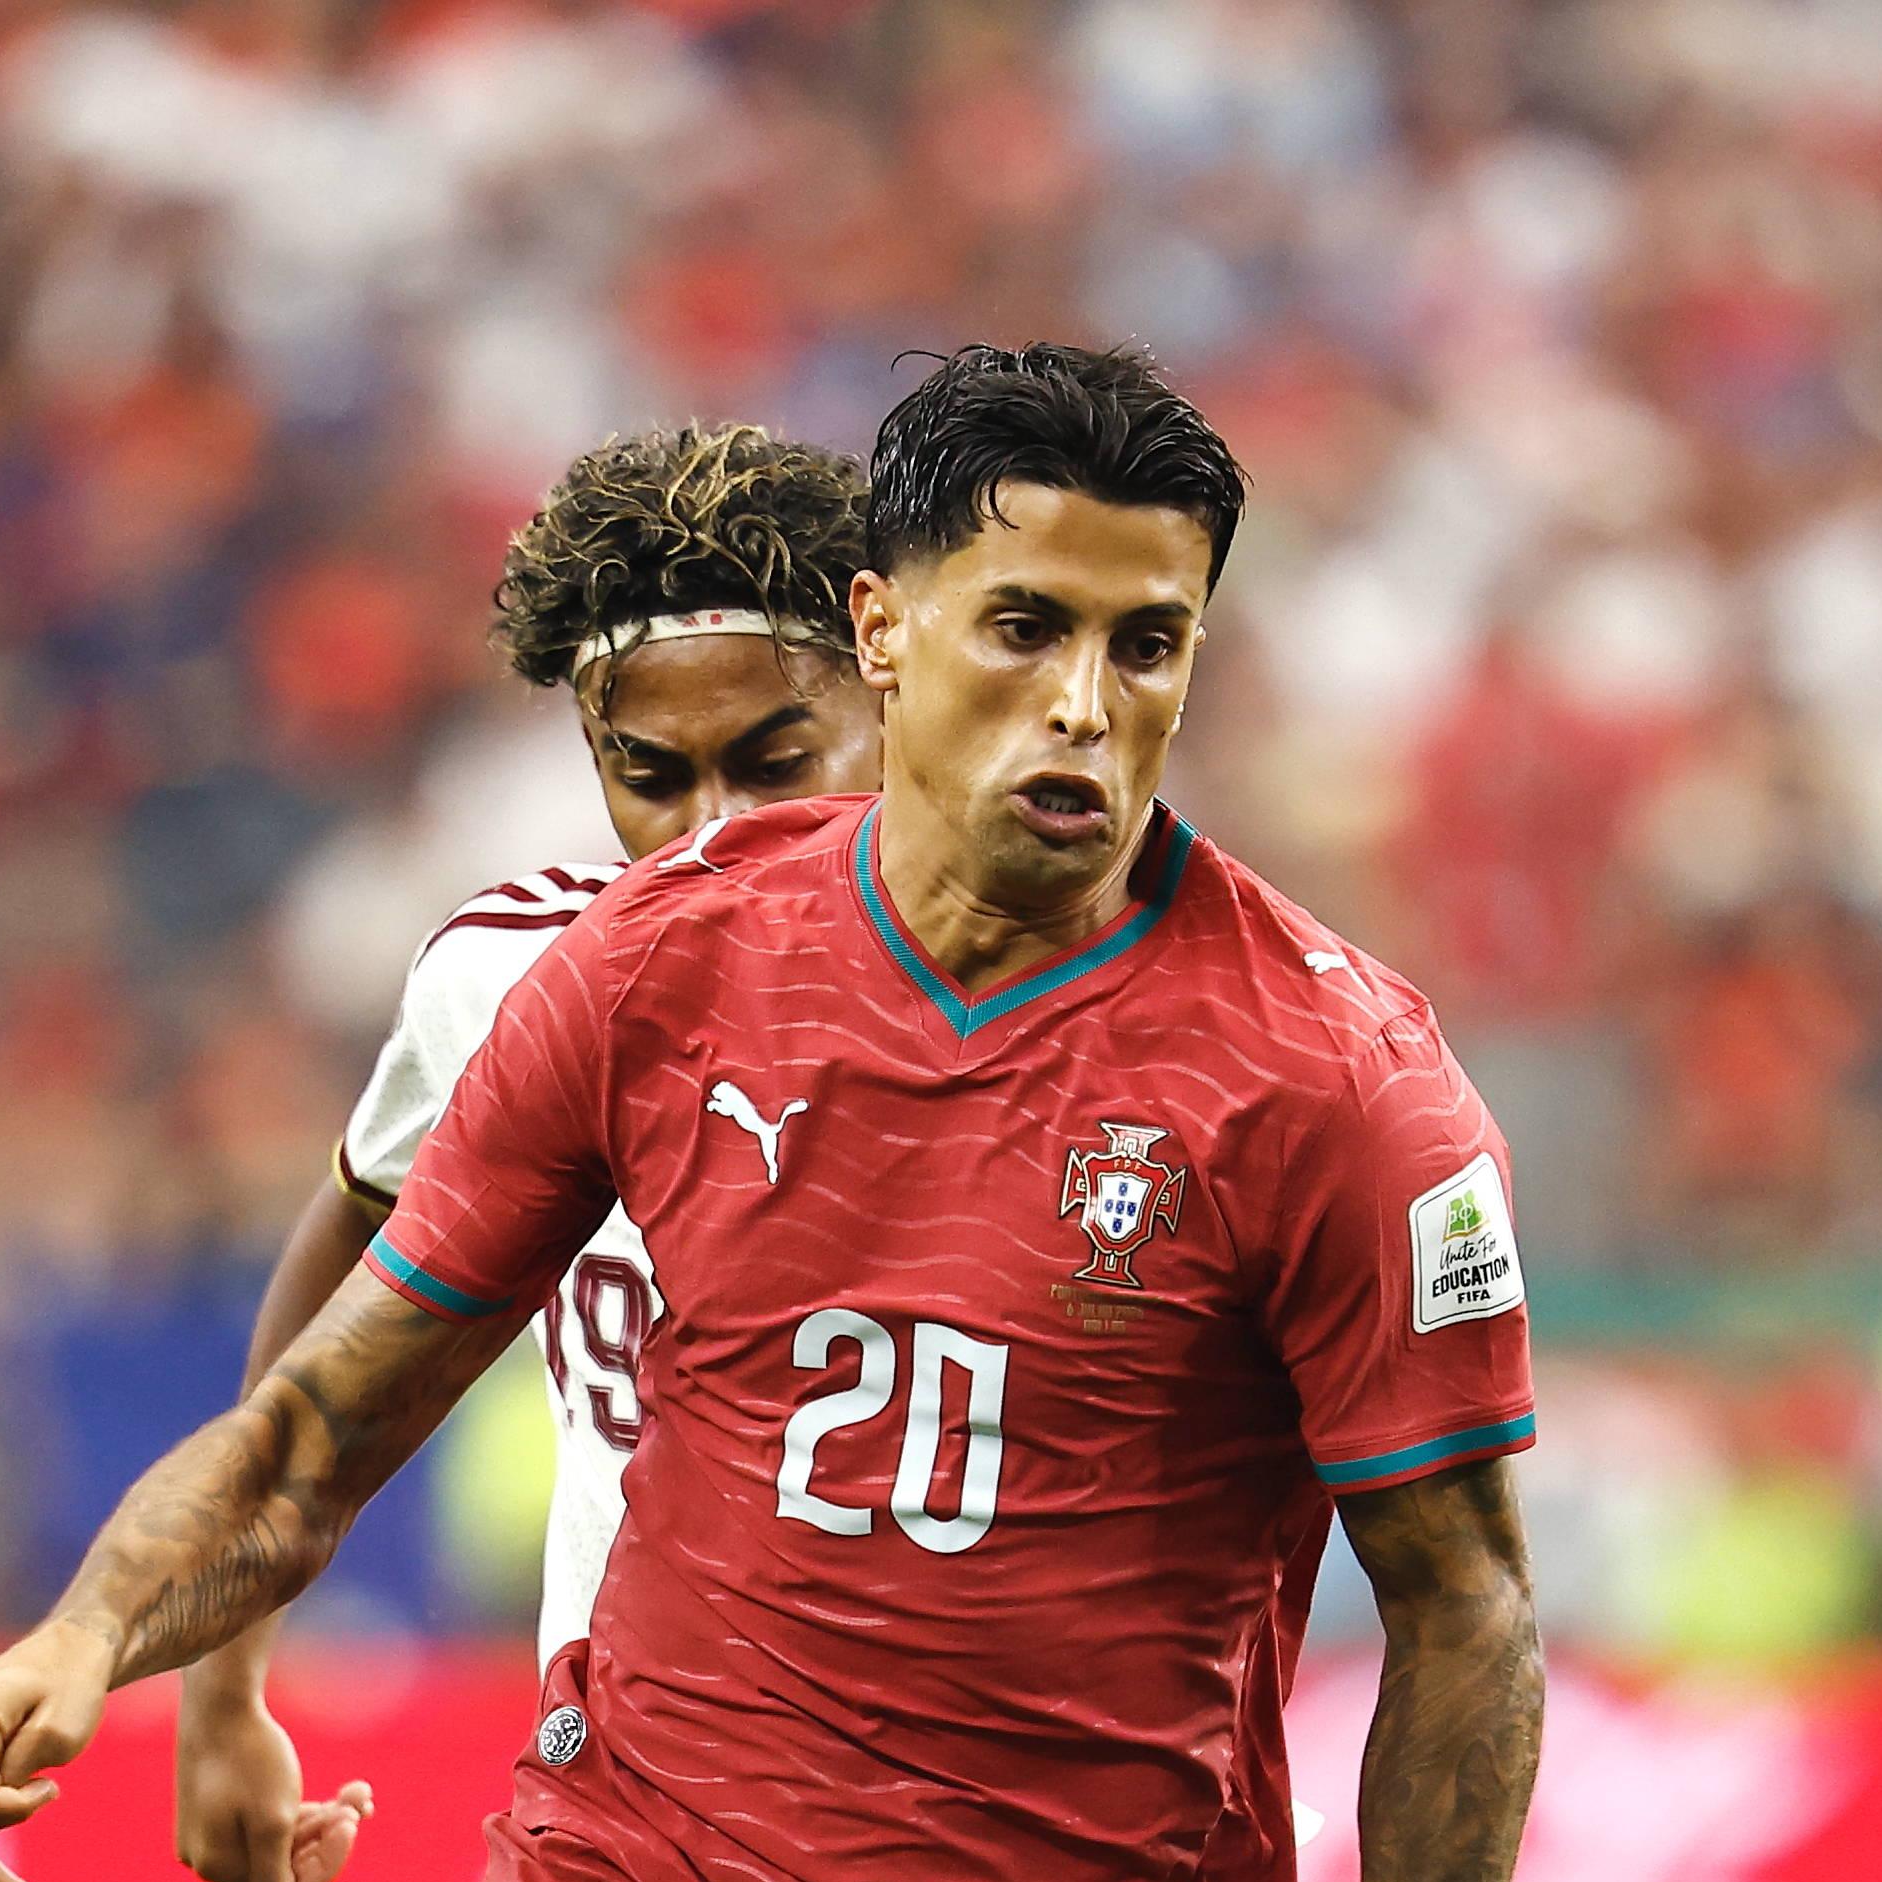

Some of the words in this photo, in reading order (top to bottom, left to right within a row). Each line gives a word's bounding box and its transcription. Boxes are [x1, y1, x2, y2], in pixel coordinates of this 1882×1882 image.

[1440, 1240, 1478, 1270] Unite
[1432, 1252, 1510, 1298] EDUCATION
[1457, 1289, 1491, 1304] FIFA
[776, 1307, 1009, 1554] 20
